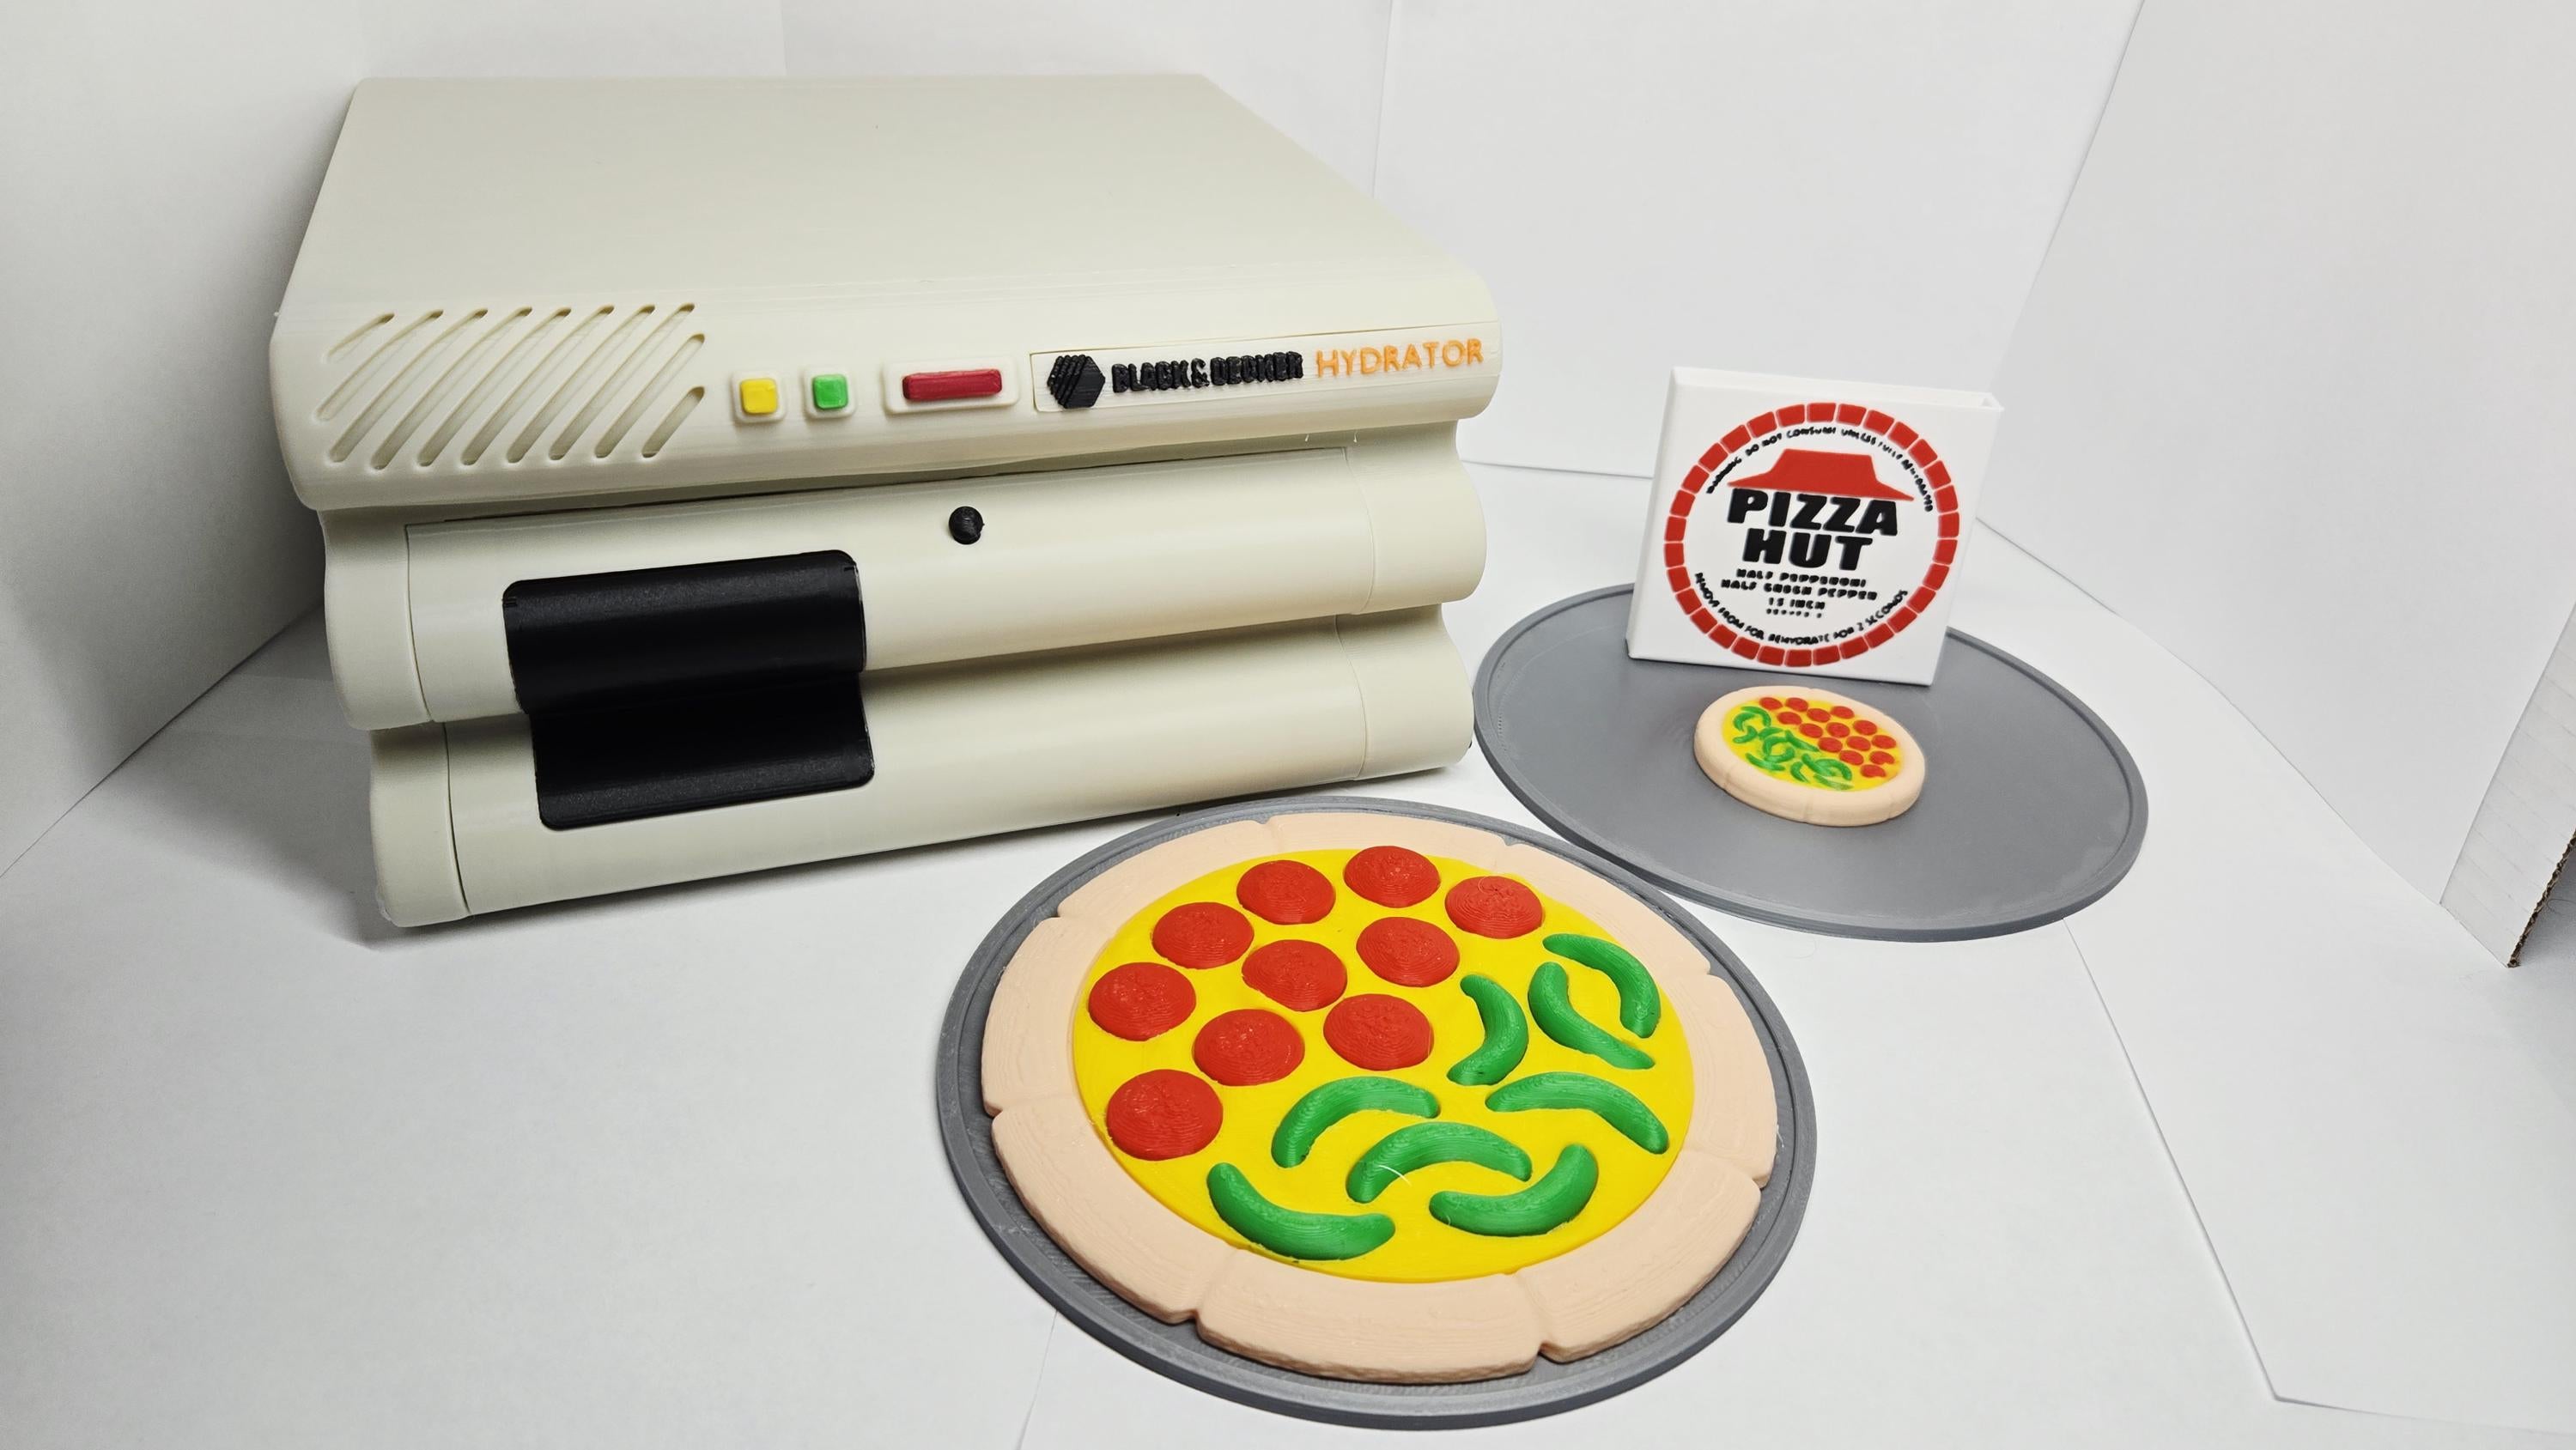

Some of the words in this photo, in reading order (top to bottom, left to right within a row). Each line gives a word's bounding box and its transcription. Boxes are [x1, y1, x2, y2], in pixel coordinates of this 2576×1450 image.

[1316, 338, 1485, 378] HYDRATOR
[1727, 487, 1899, 537] PIZZA
[1742, 528, 1874, 571] HUT
[1721, 579, 1757, 591] HALF
[1764, 583, 1812, 595] GREEN
[1818, 587, 1878, 601] PEPPER
[1736, 568, 1773, 580] HALF
[1779, 572, 1867, 588] PEPPERONI
[1789, 598, 1826, 610] INCH
[1865, 590, 1909, 626] SECONDS
